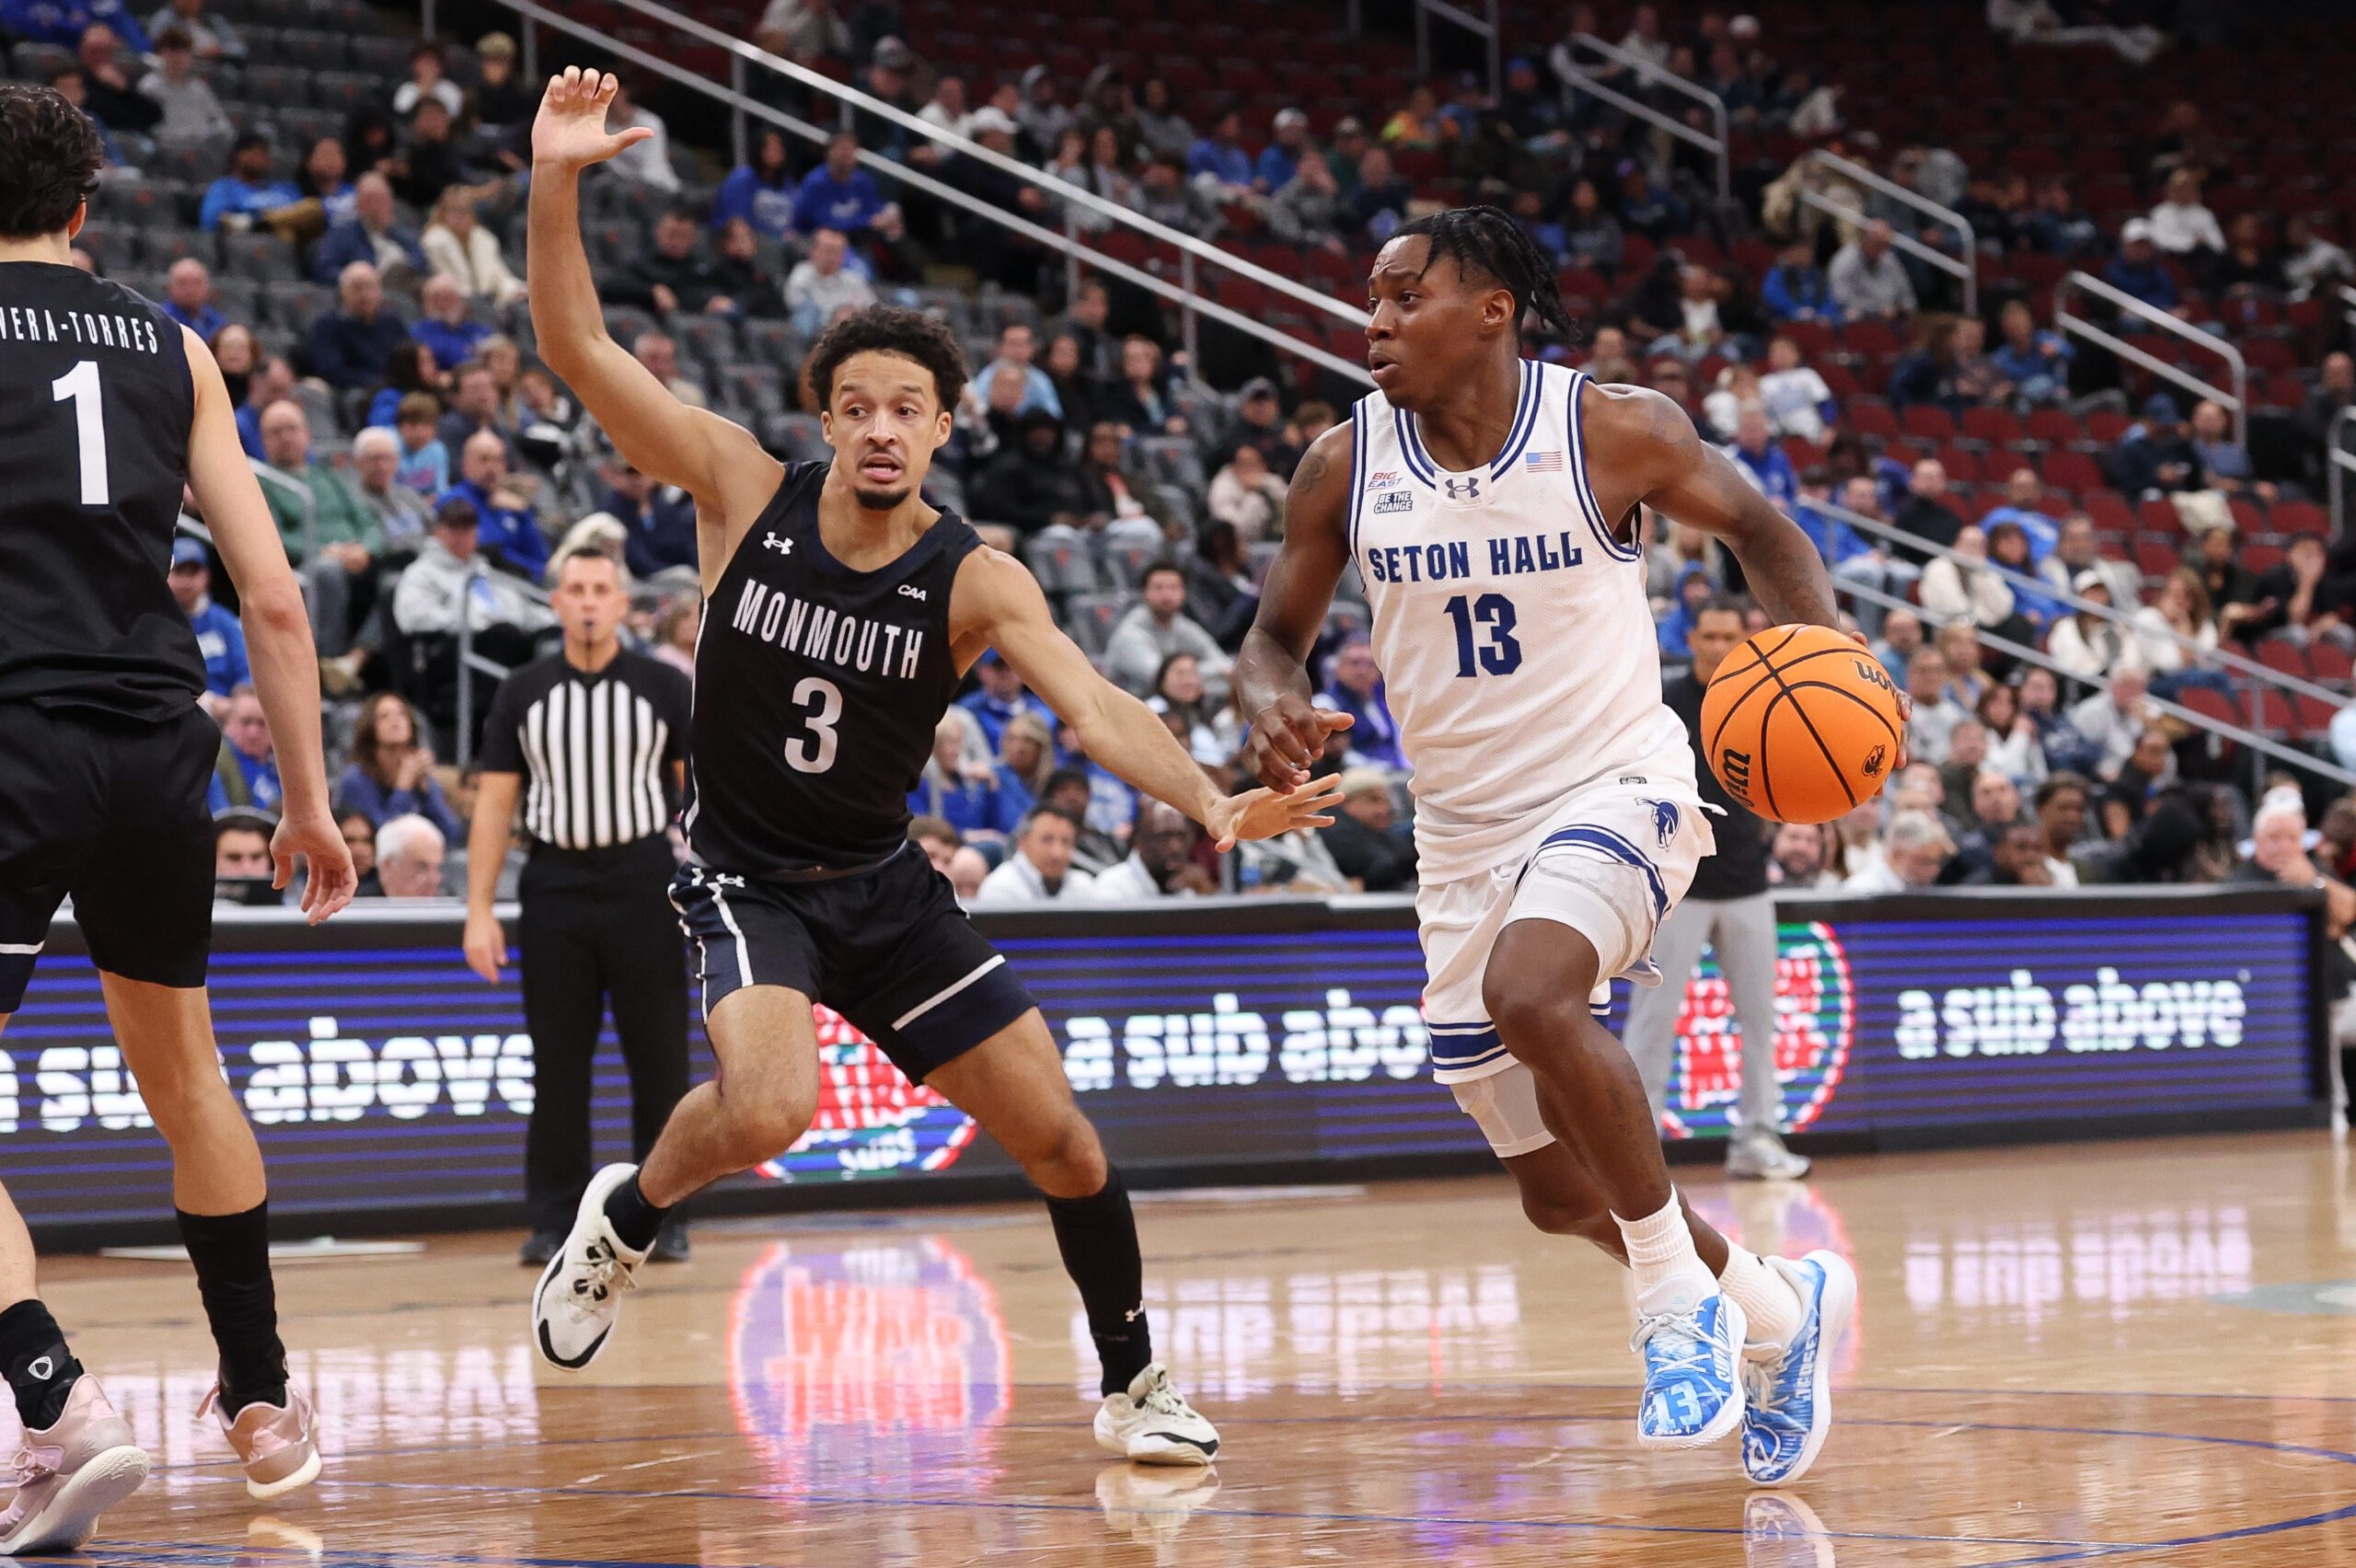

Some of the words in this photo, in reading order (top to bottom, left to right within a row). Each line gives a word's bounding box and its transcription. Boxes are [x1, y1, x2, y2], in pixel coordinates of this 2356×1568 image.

[52, 360, 110, 505] 1
[1368, 477, 1403, 488] EAST
[1372, 470, 1398, 480] BIG
[1379, 493, 1392, 504] BE
[1393, 491, 1412, 502] THE
[1374, 501, 1413, 513] CHANGE
[1368, 541, 1471, 583] SETON
[1486, 531, 1583, 576] HALL
[897, 584, 928, 601] CAA
[732, 578, 923, 679] MONMOUTH
[1443, 593, 1523, 678] 13
[784, 676, 843, 774] 3
[1894, 989, 1938, 1060] a
[1941, 968, 2058, 1058] sub
[2061, 966, 2247, 1054] above
[1063, 1016, 1115, 1092] a
[1123, 992, 1271, 1090] sub
[1277, 987, 1430, 1084] abo
[1653, 1380, 1703, 1430] 13
